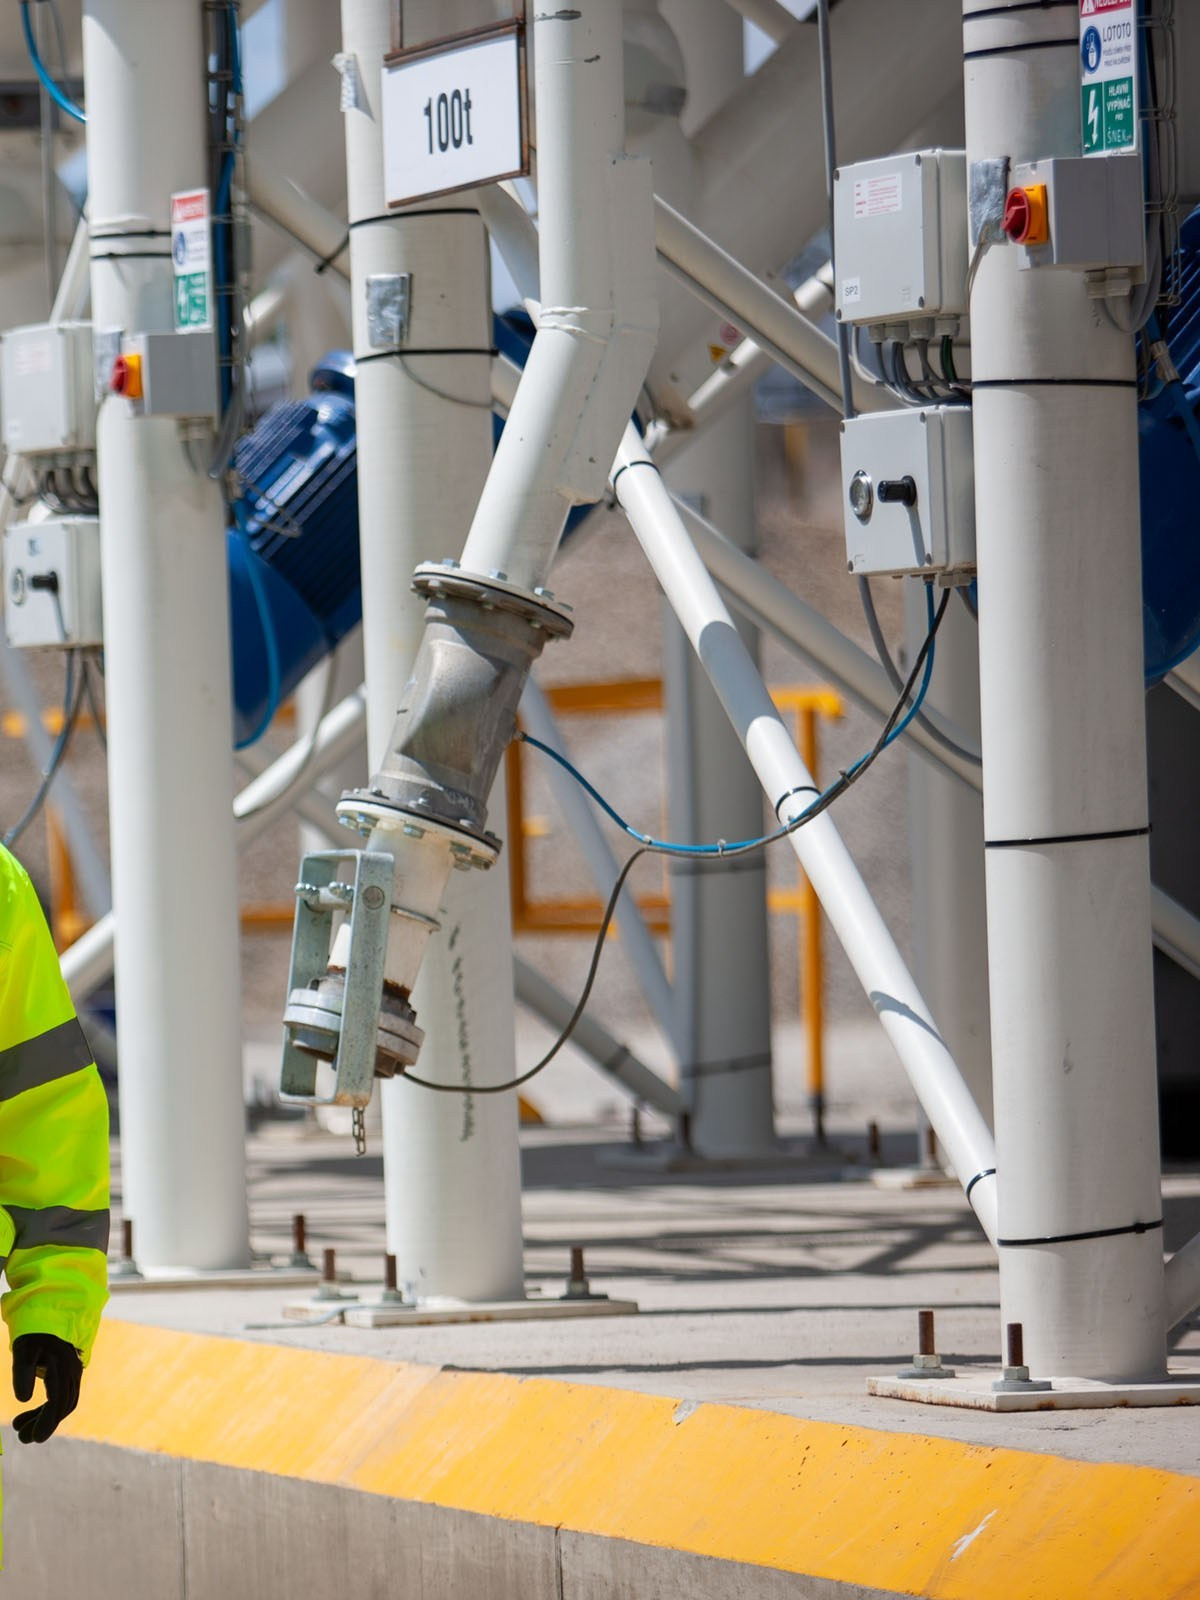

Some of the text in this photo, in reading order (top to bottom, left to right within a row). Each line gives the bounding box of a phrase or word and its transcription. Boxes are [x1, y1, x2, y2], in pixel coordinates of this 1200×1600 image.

[1102, 22, 1131, 42] LOTOTO
[424, 88, 473, 155] 100t
[844, 285, 859, 297] SP2
